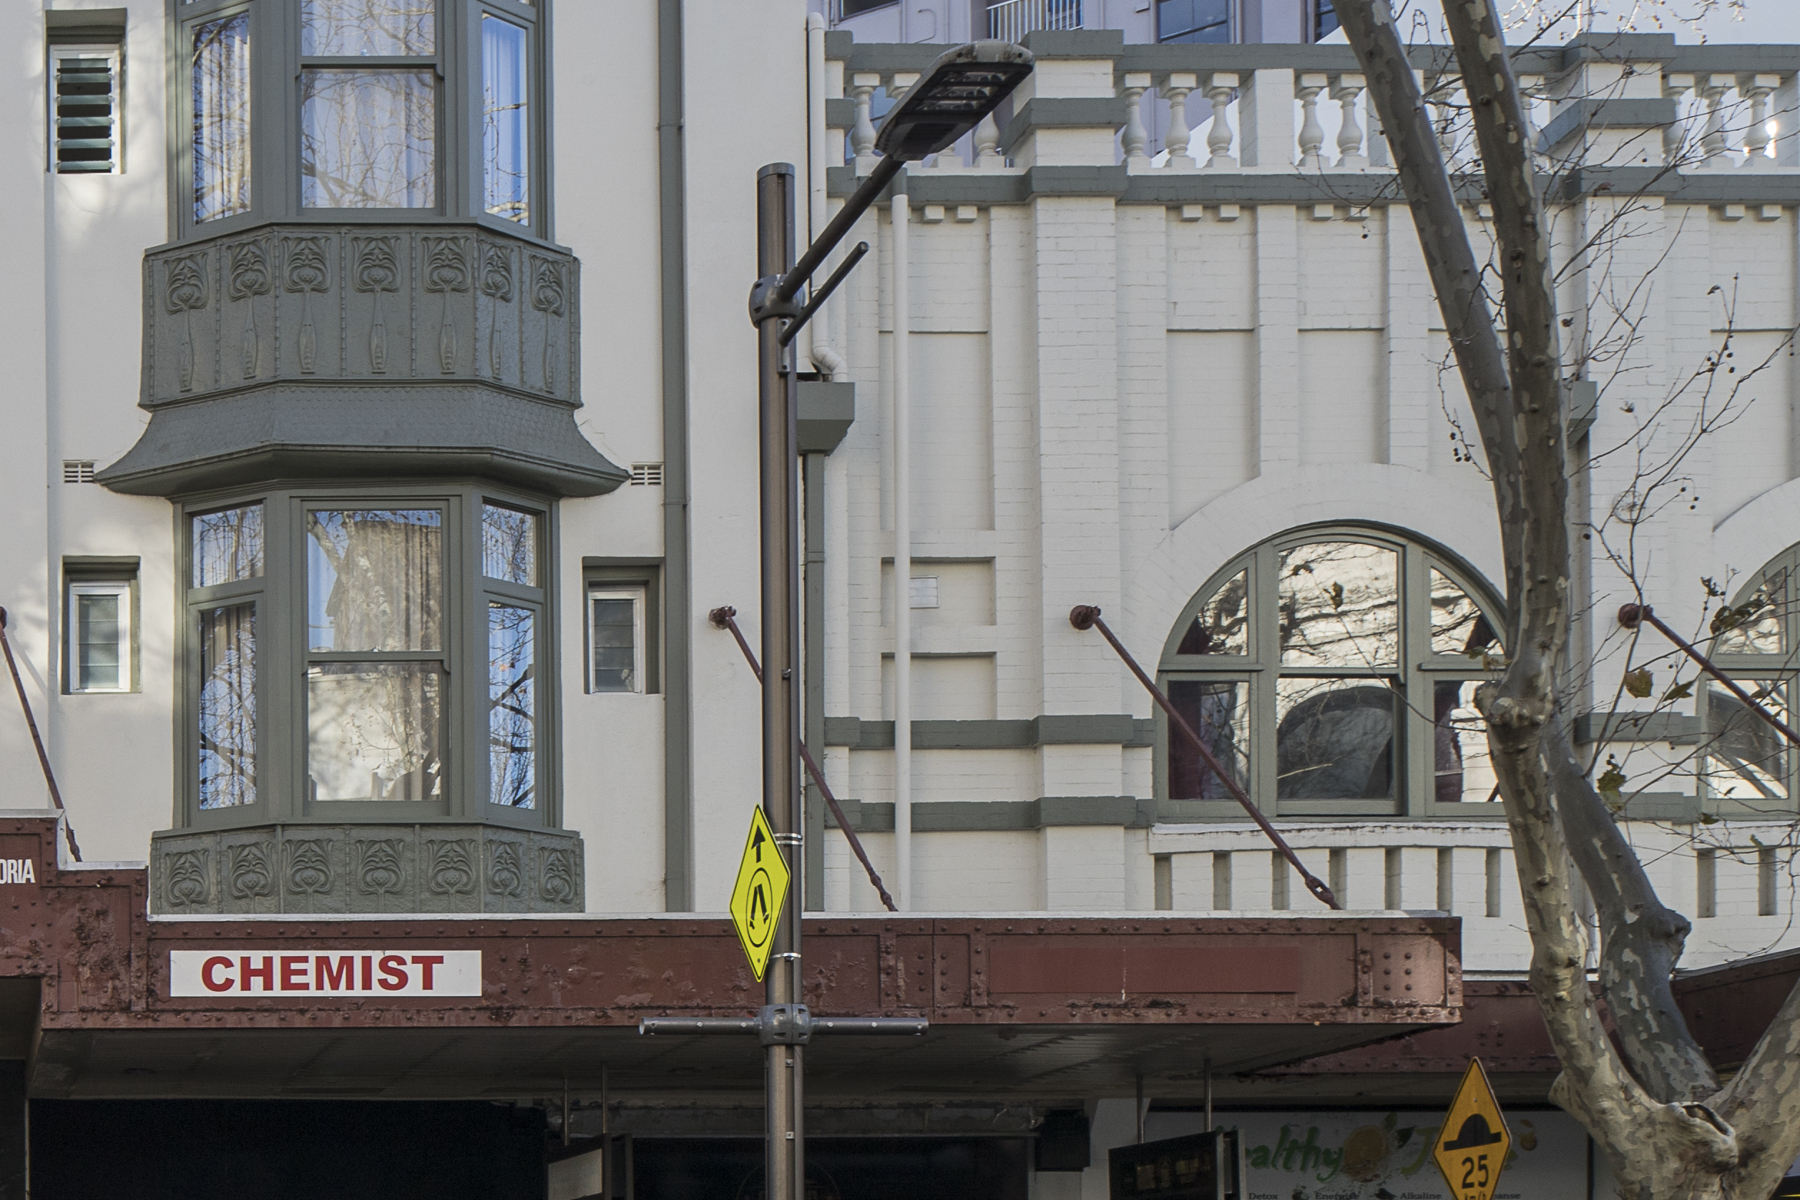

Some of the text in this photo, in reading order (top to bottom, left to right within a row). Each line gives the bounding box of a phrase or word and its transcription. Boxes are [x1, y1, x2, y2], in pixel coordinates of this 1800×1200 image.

[201, 955, 444, 992] CHEMIST
[1461, 1155, 1489, 1189] 25
[1400, 1192, 1442, 1200] Alkaline
